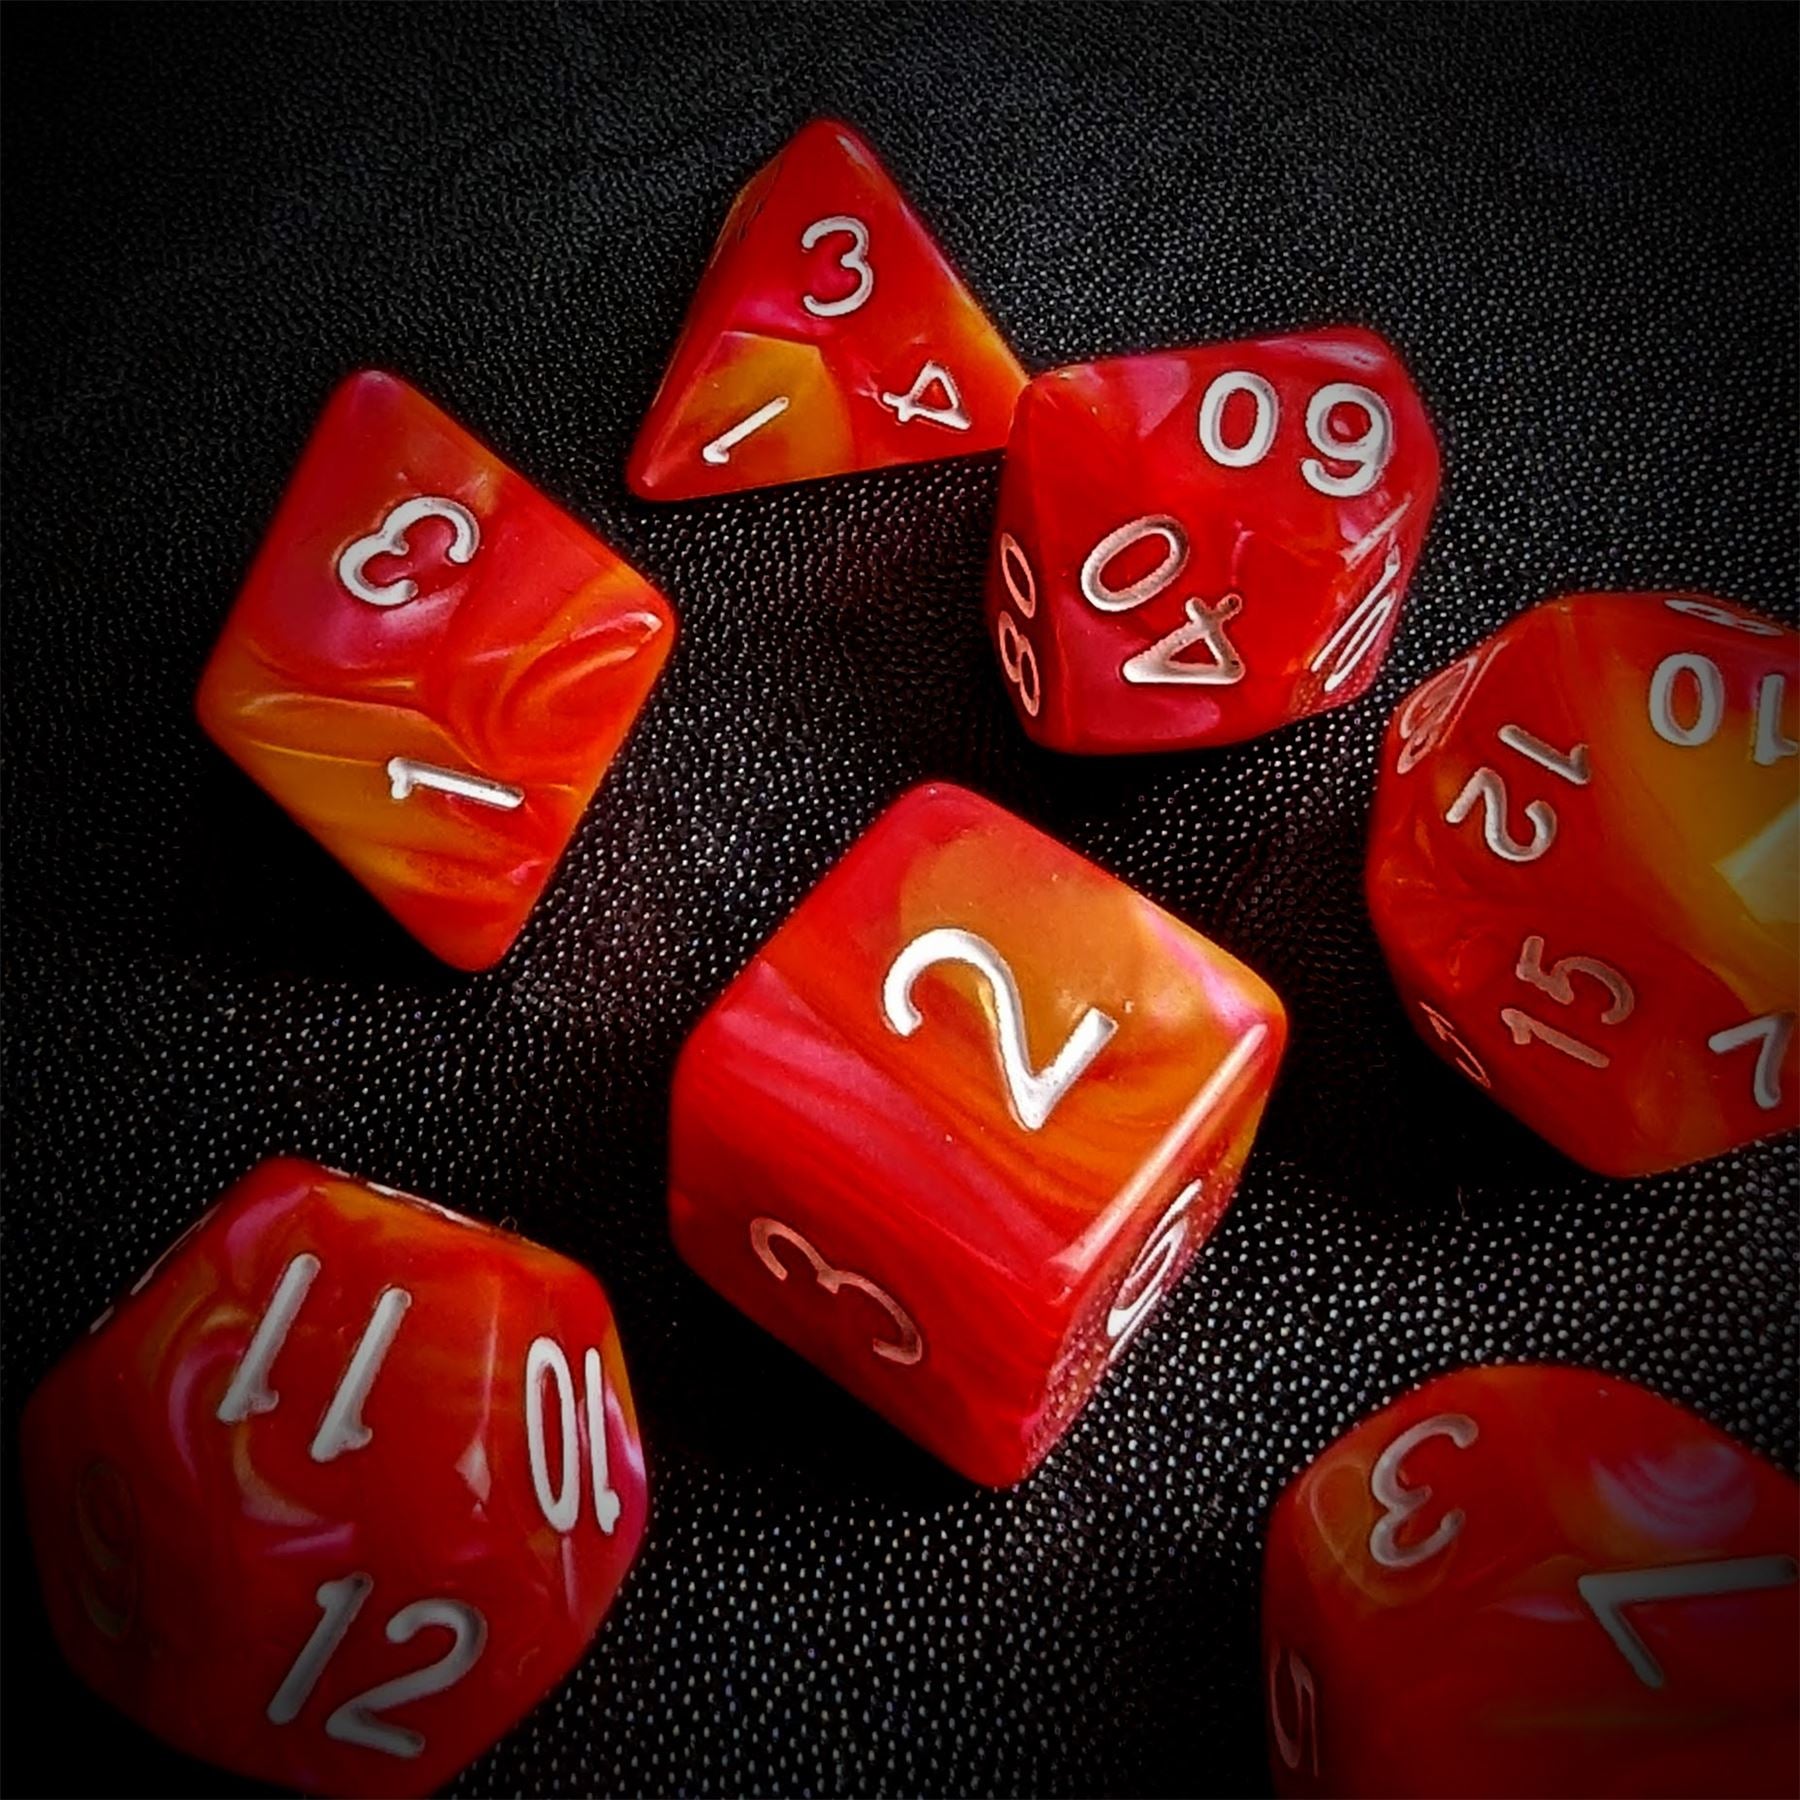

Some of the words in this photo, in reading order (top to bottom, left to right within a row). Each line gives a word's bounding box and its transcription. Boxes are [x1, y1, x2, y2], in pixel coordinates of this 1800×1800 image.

[802, 215, 873, 317] 3
[702, 396, 789, 464] 1
[882, 360, 971, 431] 4
[338, 495, 481, 606] 3
[1080, 513, 1246, 685] 40
[999, 533, 1041, 717] 80
[1648, 651, 1799, 767] 10
[386, 756, 525, 809] 1
[1445, 724, 1591, 863] 12
[883, 927, 1119, 1133] 2
[1501, 935, 1635, 1069] 15
[1707, 1012, 1794, 1110] 7
[217, 1253, 412, 1463] 11
[750, 1216, 923, 1366] 3
[525, 1337, 622, 1536] 10
[1369, 1412, 1479, 1568] 3
[265, 1571, 488, 1758] 12
[1577, 1554, 1799, 1690] 7
